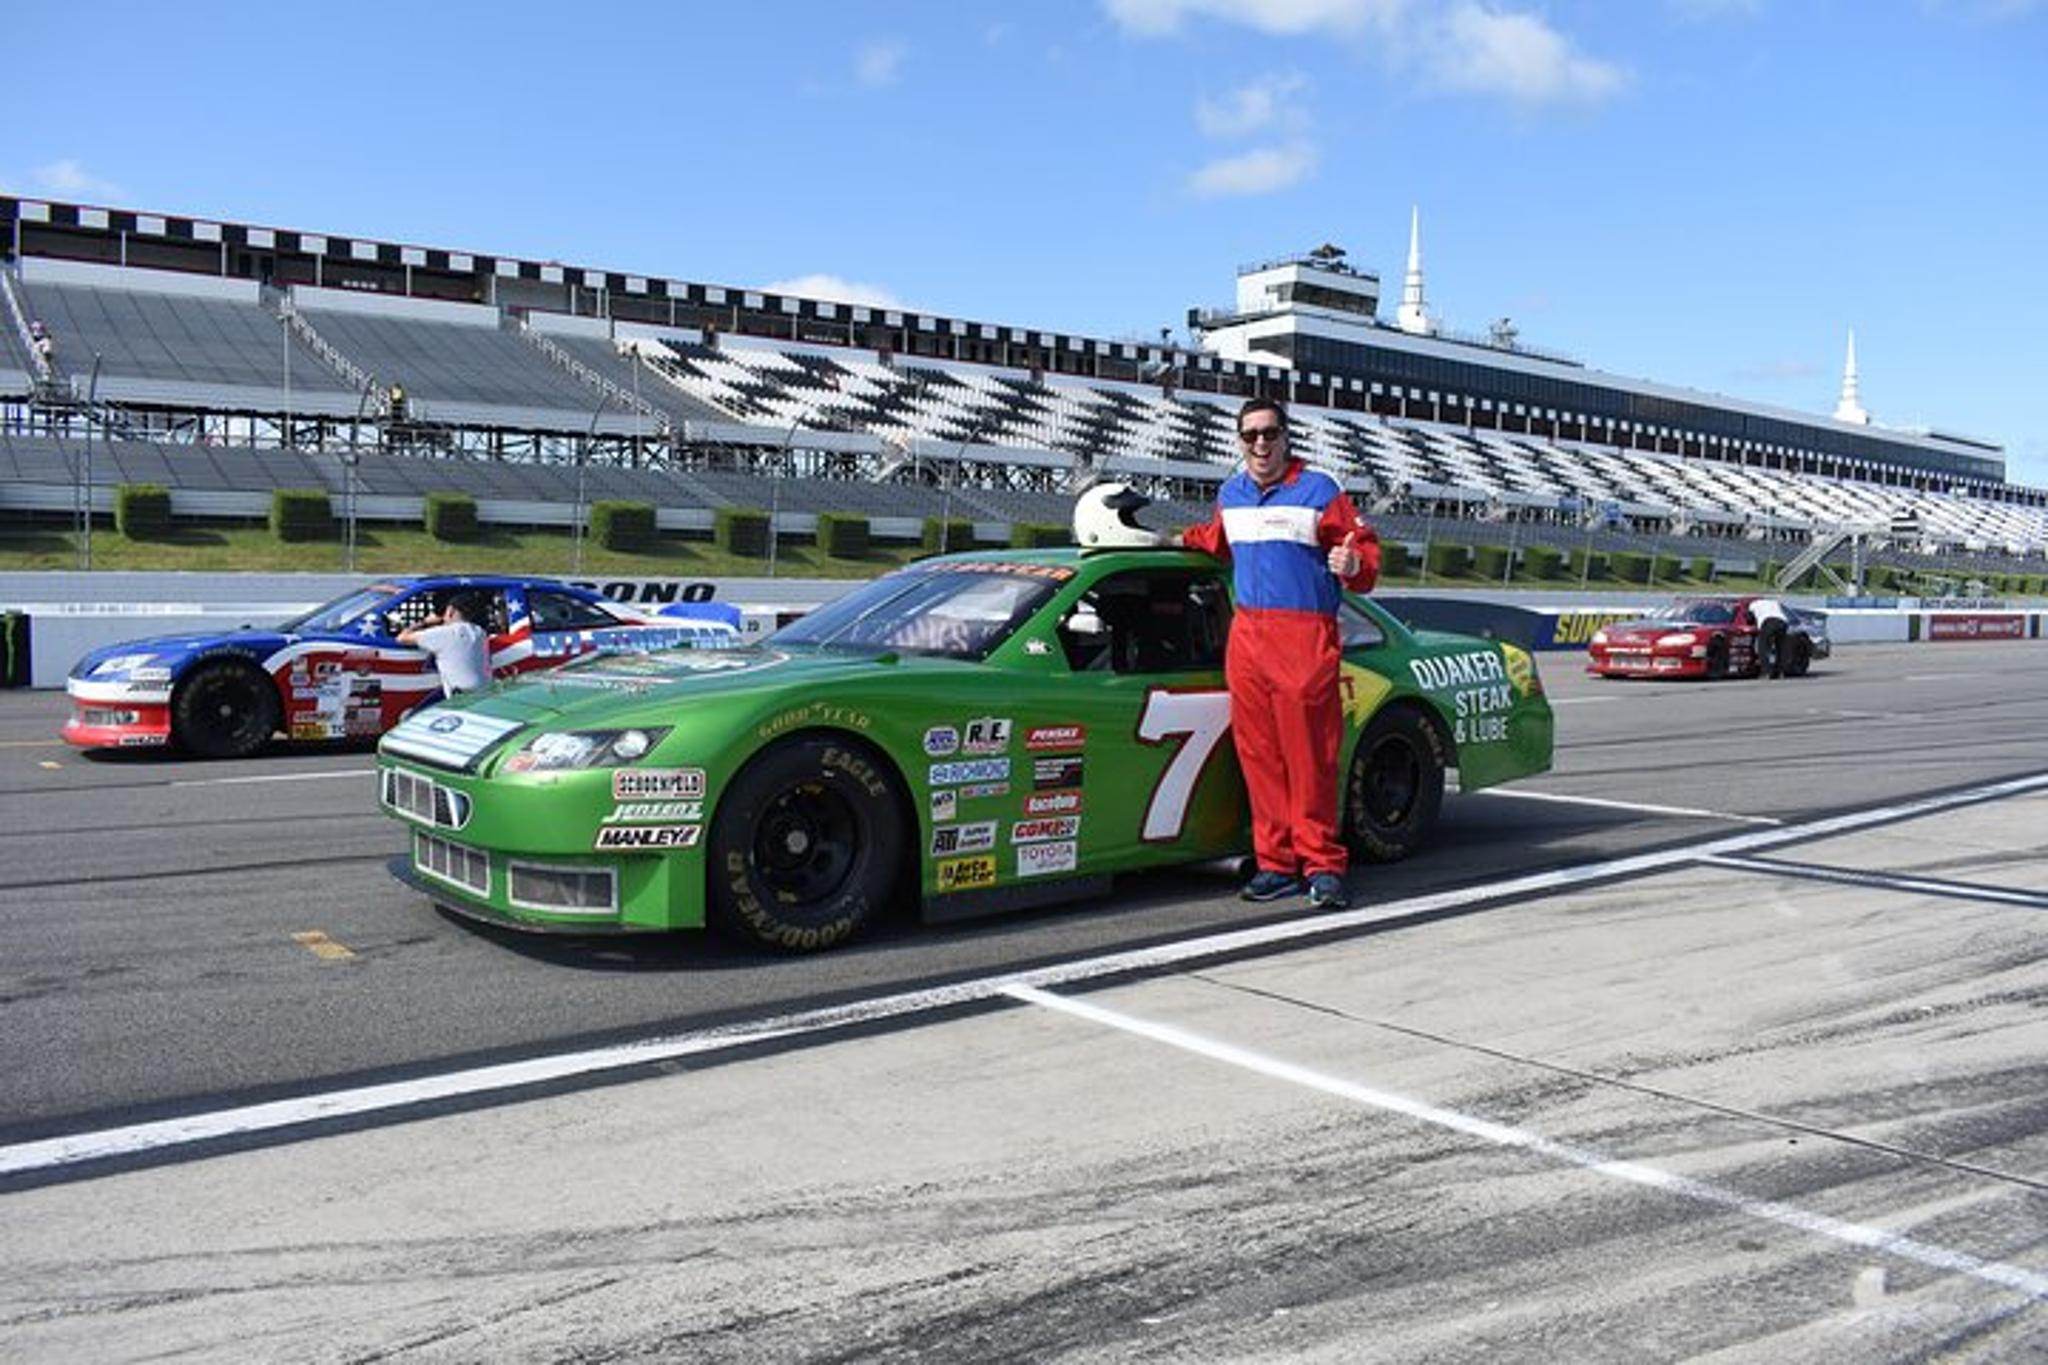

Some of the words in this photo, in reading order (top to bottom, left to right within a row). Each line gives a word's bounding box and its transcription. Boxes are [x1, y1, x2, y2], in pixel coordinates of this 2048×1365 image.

[1410, 650, 1503, 690] QUAKER
[1456, 685, 1513, 717] STEAK
[1455, 720, 1466, 743] &
[1469, 716, 1509, 741] LUBE
[822, 748, 887, 796] EAGLE
[1137, 687, 1233, 841] 7
[600, 829, 684, 846] MANLEY
[1021, 845, 1073, 860] TOYOTA
